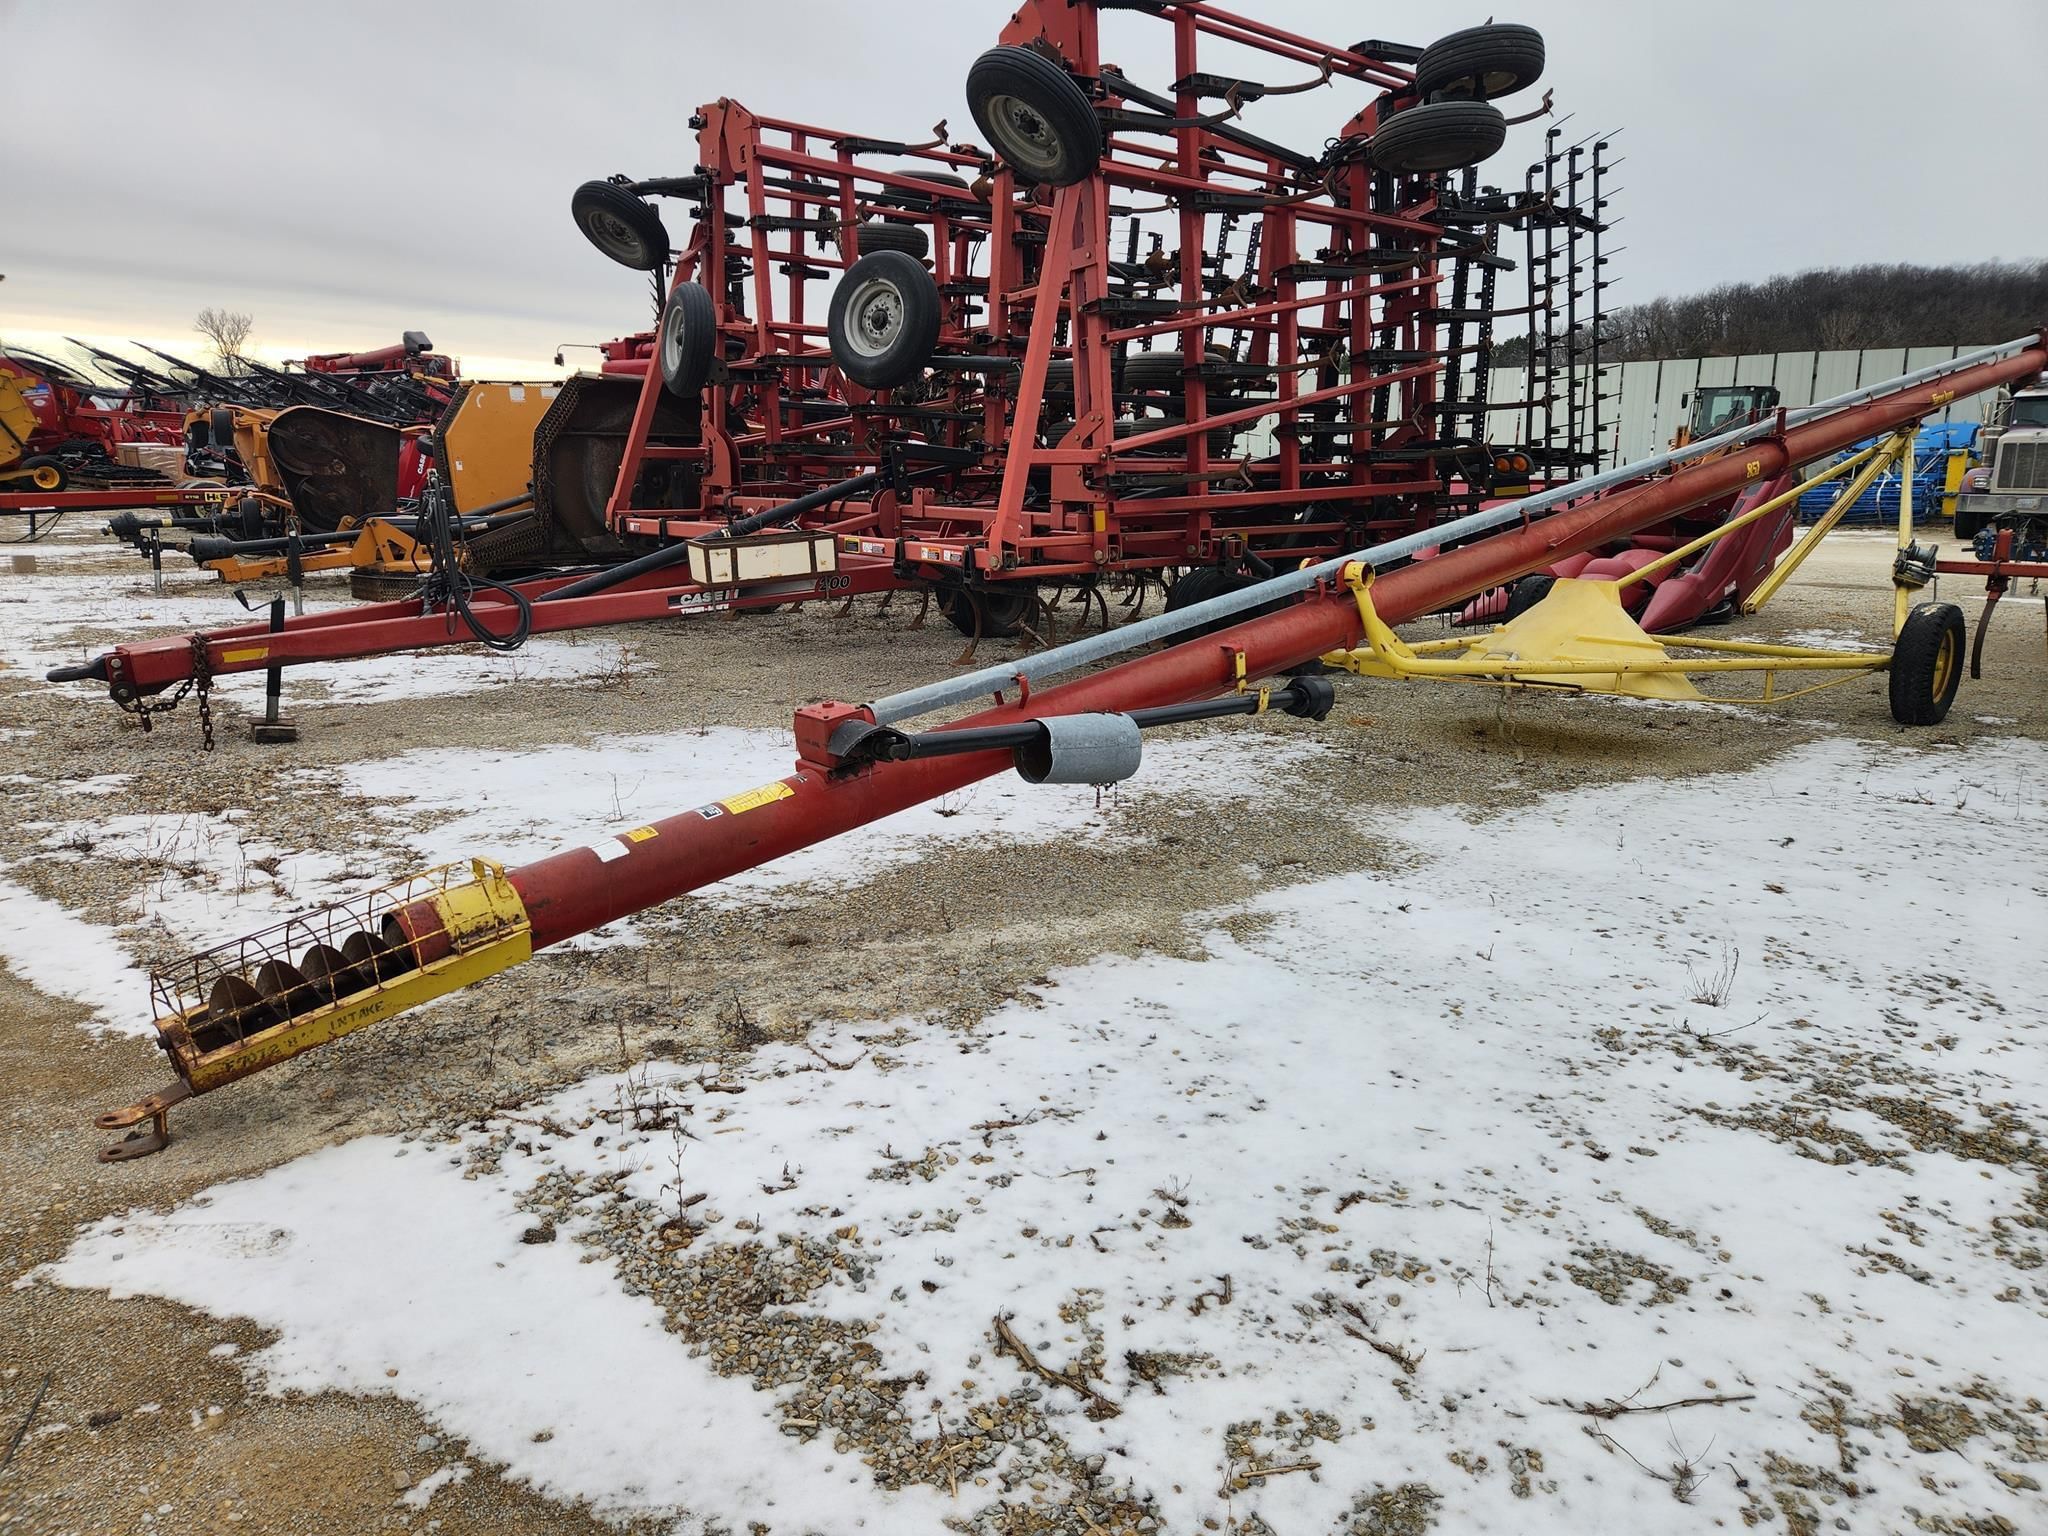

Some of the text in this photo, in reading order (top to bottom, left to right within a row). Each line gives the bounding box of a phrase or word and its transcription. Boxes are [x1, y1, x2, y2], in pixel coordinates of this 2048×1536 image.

[417, 453, 426, 474] CASE
[680, 591, 724, 605] CASE
[330, 1001, 384, 1030] INTAKE
